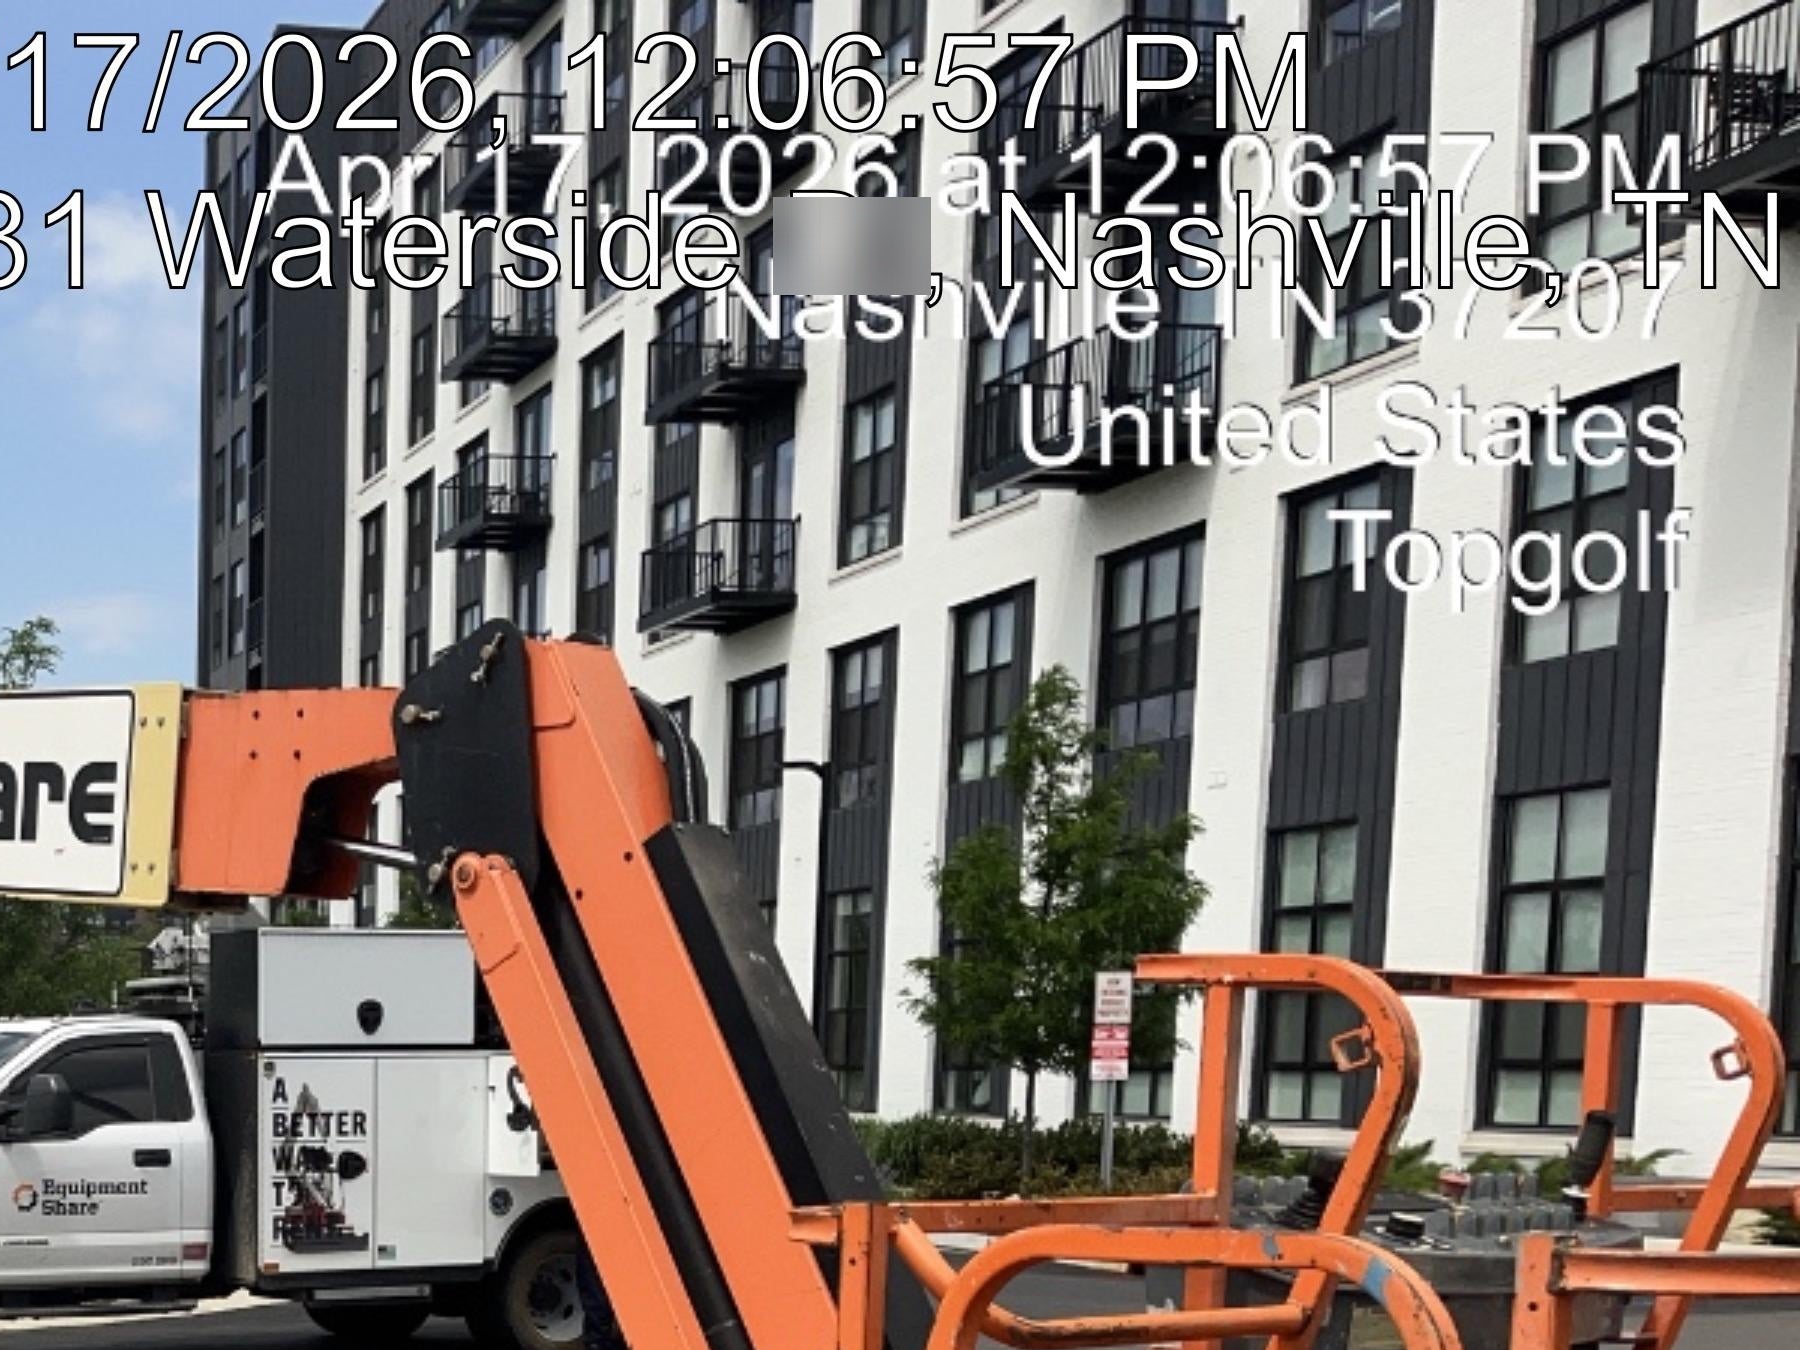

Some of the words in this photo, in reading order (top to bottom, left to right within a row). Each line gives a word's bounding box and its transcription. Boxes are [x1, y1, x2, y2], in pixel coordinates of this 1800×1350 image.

[272, 1076, 288, 1103] A
[272, 1110, 367, 1138] BETTER
[42, 1178, 148, 1198] Equipment
[42, 1199, 100, 1216] Share
